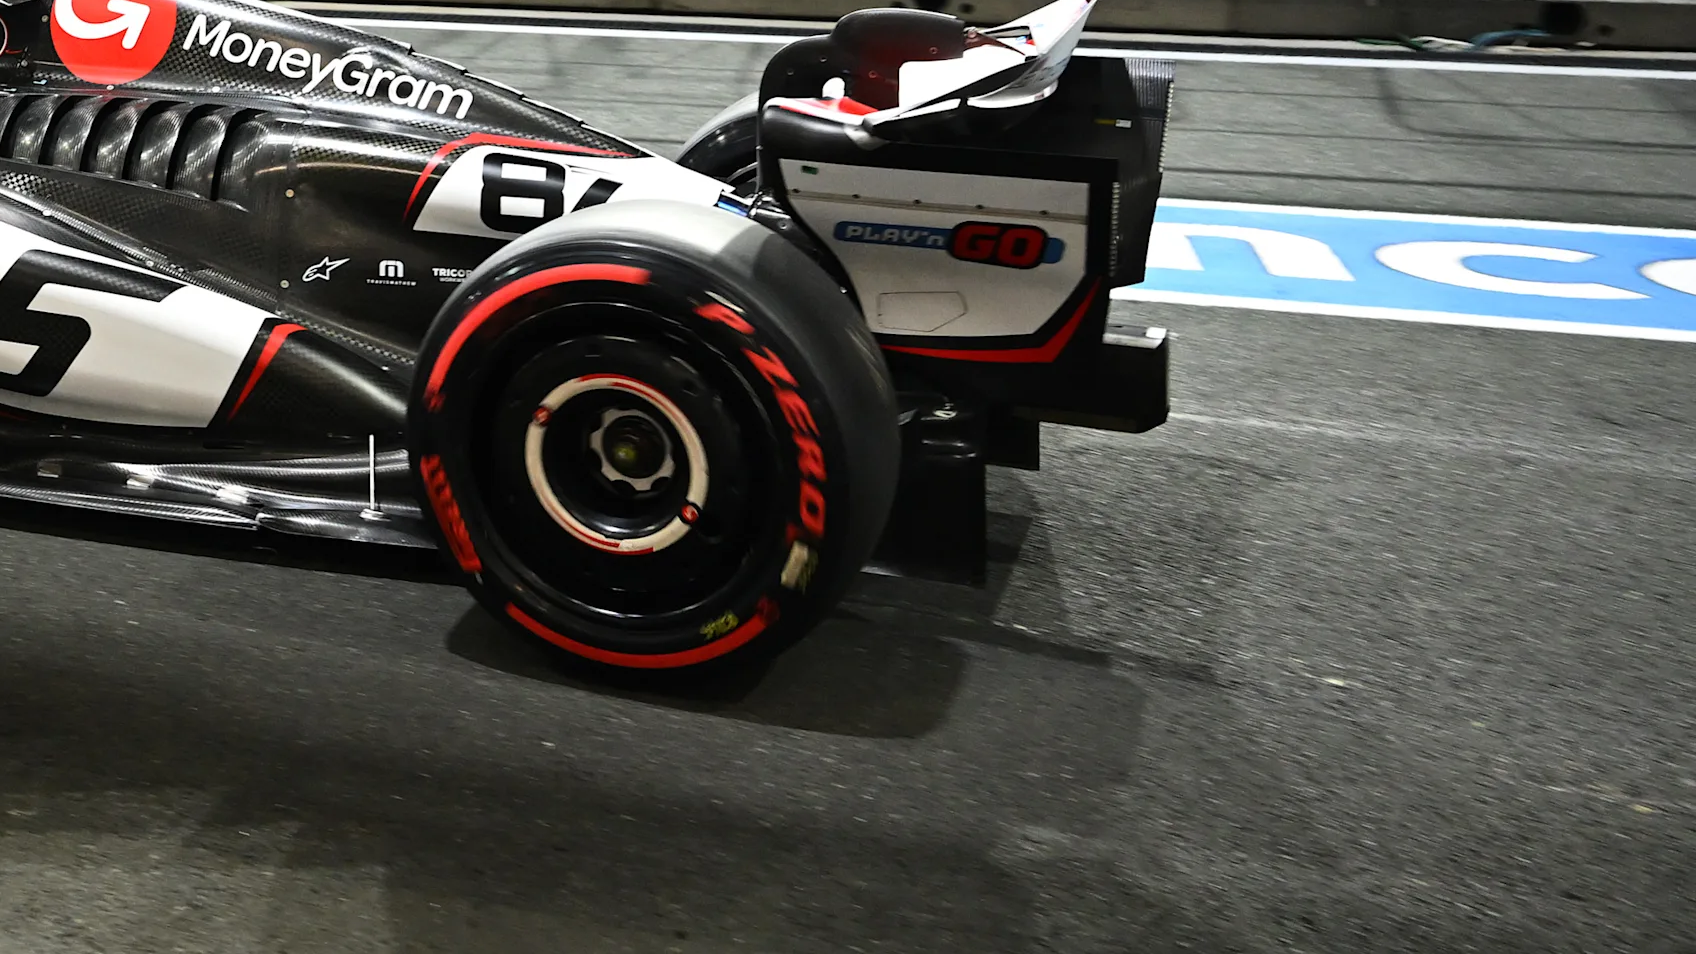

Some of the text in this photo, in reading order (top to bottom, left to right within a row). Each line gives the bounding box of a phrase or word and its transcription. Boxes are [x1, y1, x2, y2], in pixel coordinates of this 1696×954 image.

[182, 14, 474, 120] MoneyGram
[431, 268, 472, 278] TRICOR
[845, 224, 1046, 268] PLAY'n GO
[740, 345, 827, 539] ZERO
